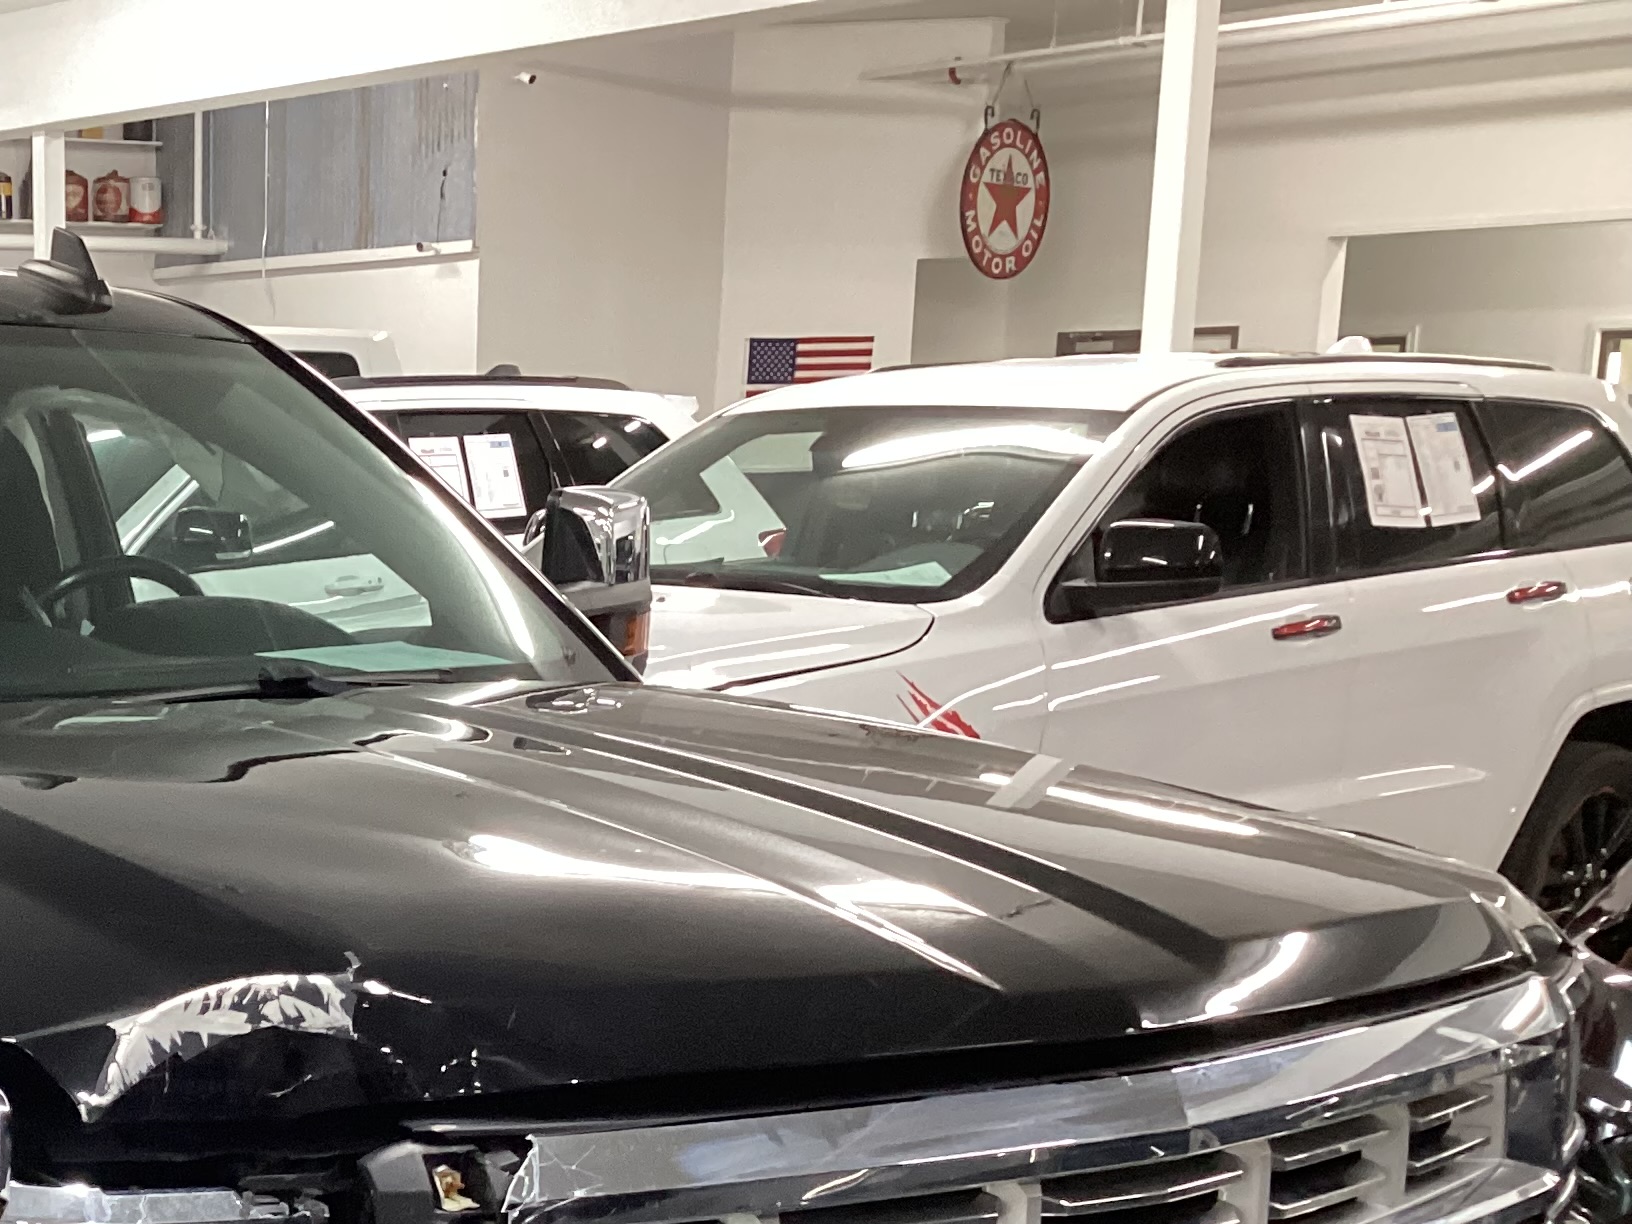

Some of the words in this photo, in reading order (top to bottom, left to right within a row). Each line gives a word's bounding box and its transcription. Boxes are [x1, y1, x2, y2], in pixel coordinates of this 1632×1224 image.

[970, 127, 1045, 187] GASOLINE
[965, 210, 1017, 273] MOTOR
[1023, 215, 1043, 257] OIL
